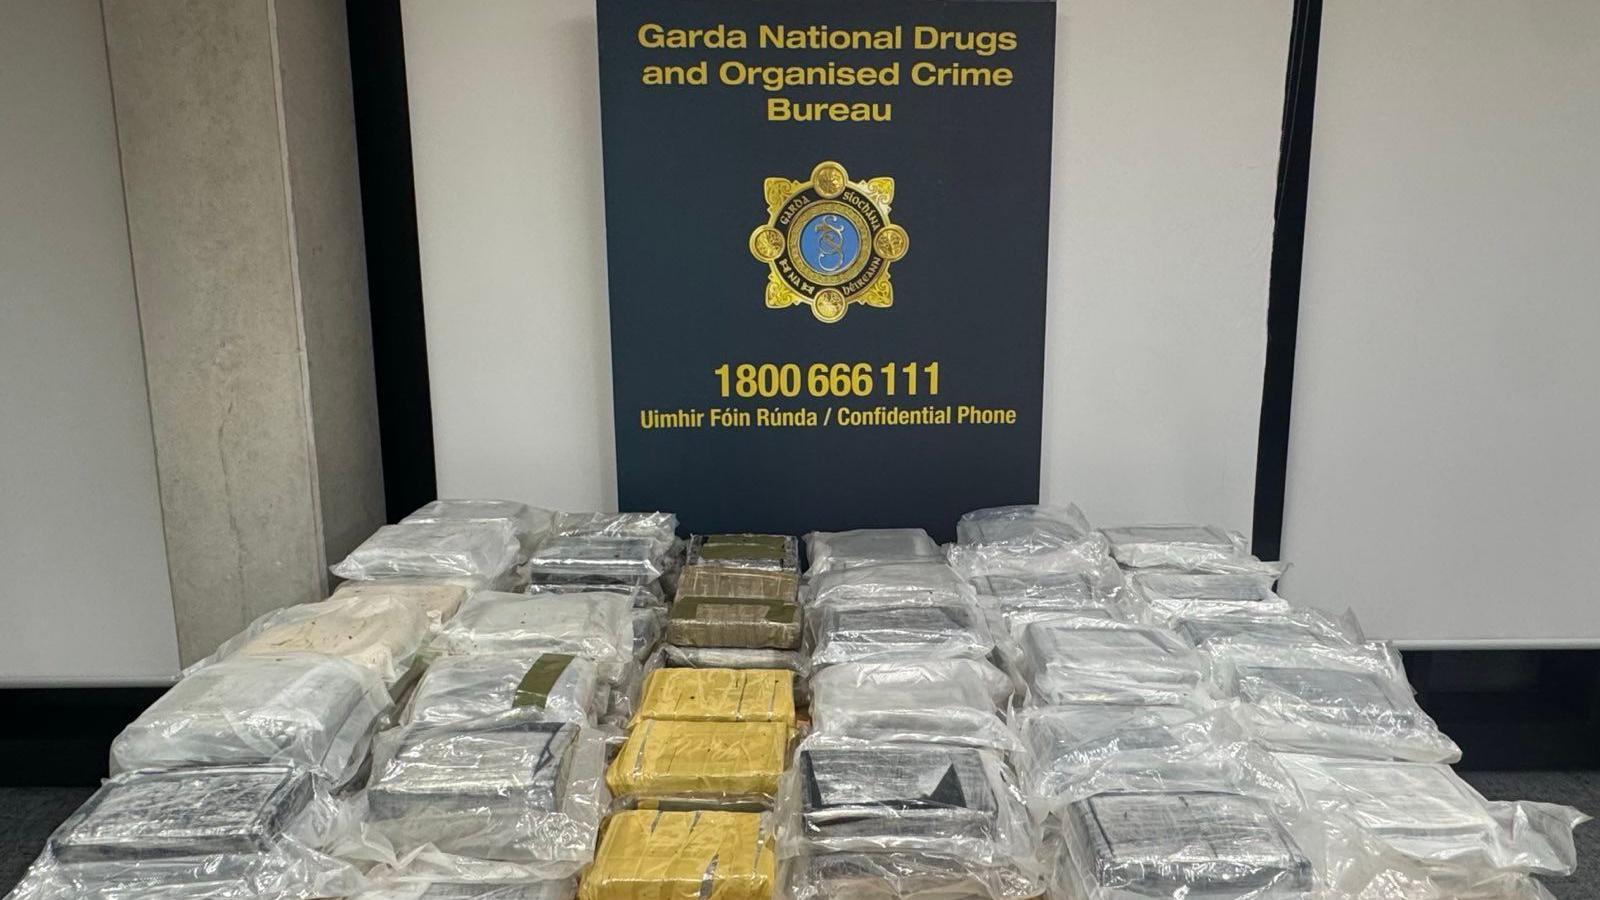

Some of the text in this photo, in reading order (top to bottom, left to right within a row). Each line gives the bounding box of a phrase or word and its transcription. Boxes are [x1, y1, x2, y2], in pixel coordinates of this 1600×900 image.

[638, 24, 1018, 55] Garda National Drugs
[642, 60, 1013, 92] and Organised Crime
[767, 97, 893, 122] Bureau
[714, 361, 940, 398] 1800 666 111
[640, 404, 1018, 429] Uimhir Fóin Rúnda / Confidential Phone
